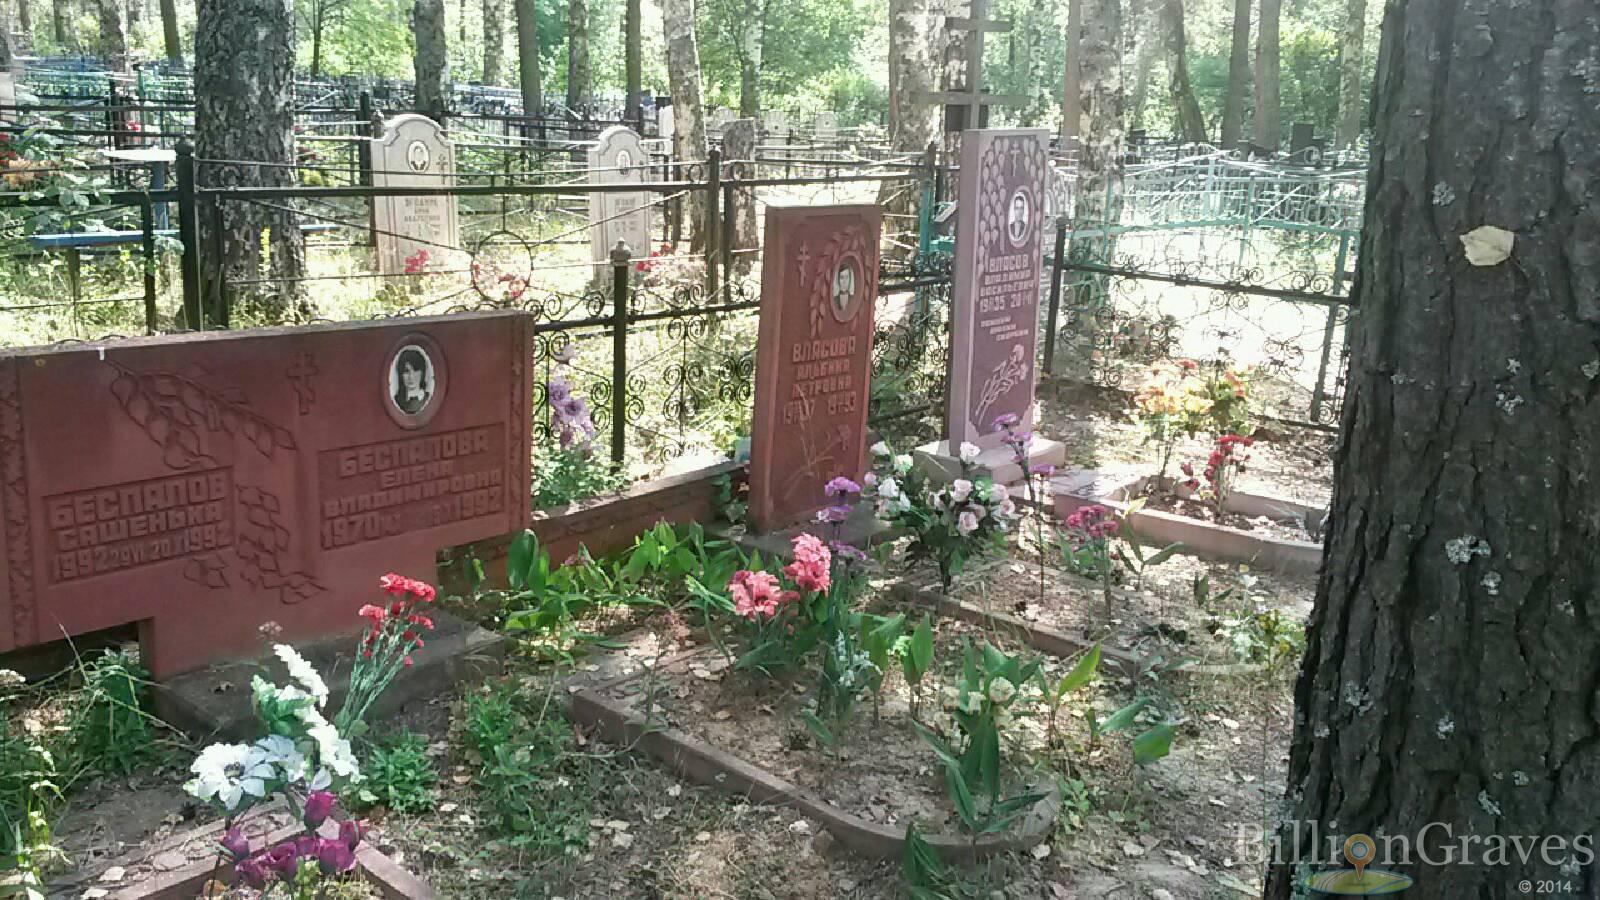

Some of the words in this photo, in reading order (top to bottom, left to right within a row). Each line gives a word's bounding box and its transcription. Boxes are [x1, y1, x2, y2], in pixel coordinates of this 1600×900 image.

[989, 254, 1029, 273] ВЛАСОВ
[792, 335, 857, 363] ВЛАСОВА
[341, 432, 489, 476] БЕСПАЛОВА
[383, 460, 454, 487] ЕЛЕНА
[54, 472, 227, 528] БЕСПАЛОВ
[56, 501, 222, 549] САШЕНЬКА
